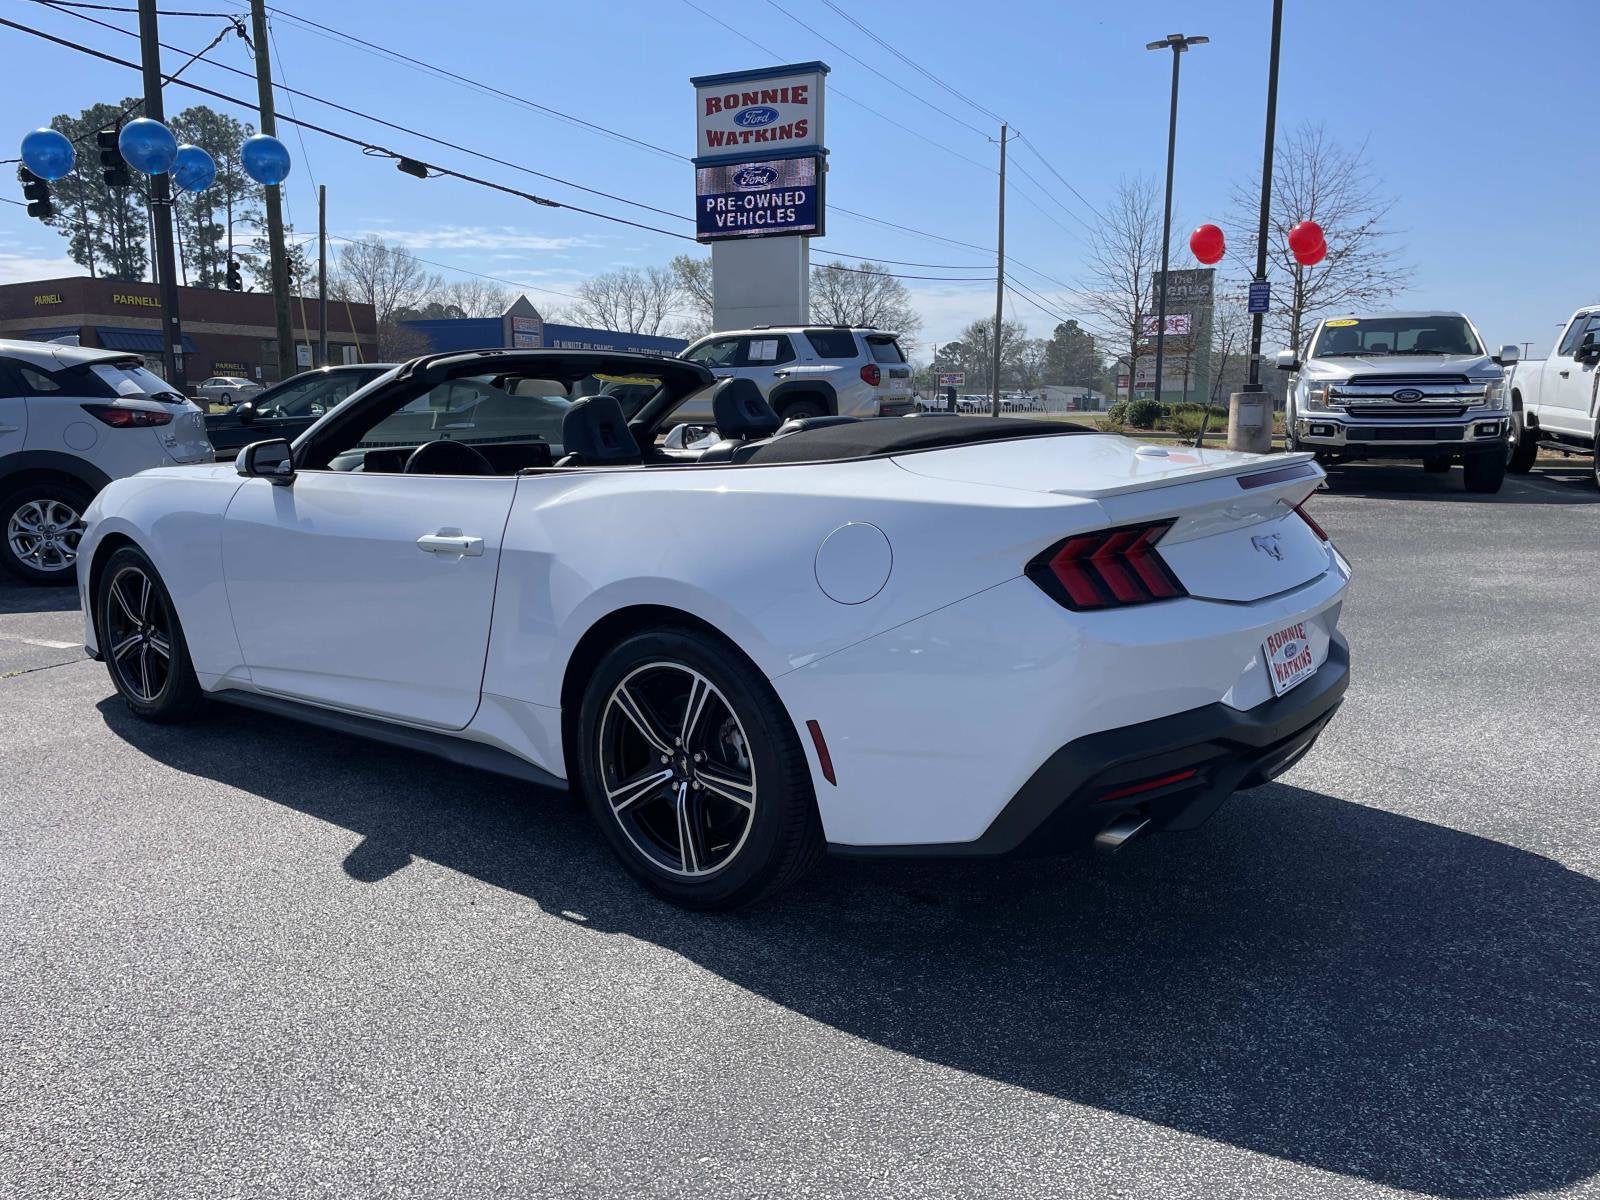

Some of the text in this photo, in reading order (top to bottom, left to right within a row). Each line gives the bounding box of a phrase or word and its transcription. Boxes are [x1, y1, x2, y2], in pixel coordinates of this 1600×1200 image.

[705, 85, 809, 116] RONNIE
[742, 110, 770, 125] Ford
[705, 119, 808, 148] WATKINS
[740, 169, 769, 185] Ford
[706, 191, 806, 212] PRE-OWNED
[715, 208, 796, 227] VEHICLES
[34, 294, 62, 305] PARNELL
[113, 294, 161, 306] PARNELL
[1266, 622, 1306, 657] RONNIE
[1273, 644, 1312, 683] WATKINS
